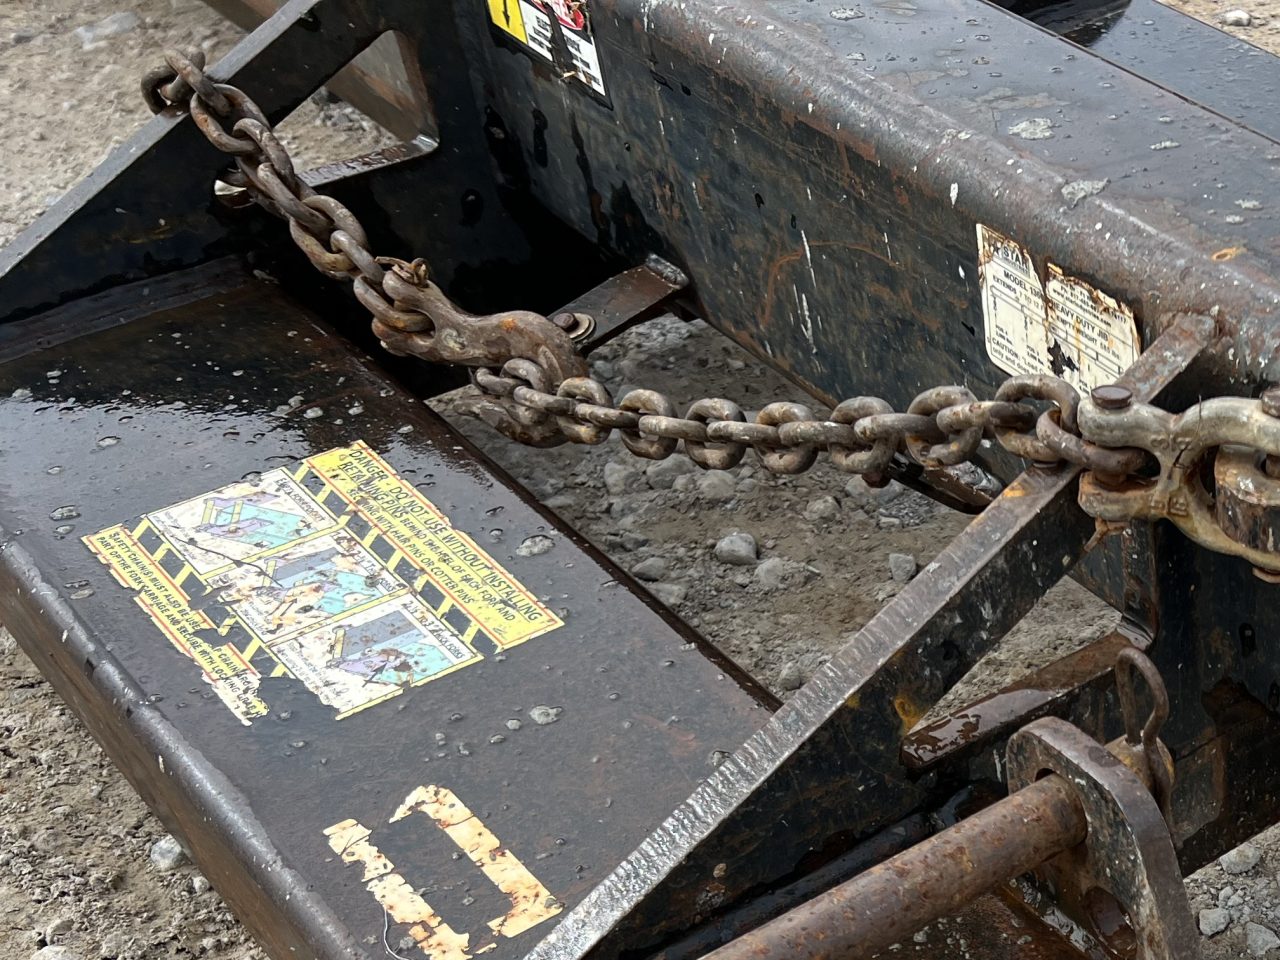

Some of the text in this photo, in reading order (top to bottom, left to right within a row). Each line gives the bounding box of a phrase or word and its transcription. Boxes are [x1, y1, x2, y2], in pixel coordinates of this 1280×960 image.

[992, 273, 1016, 295] EXTENDS
[1003, 269, 1028, 292] MODEL
[1051, 299, 1074, 320] HEAVY
[1075, 314, 1095, 334] DUTY
[1096, 327, 1108, 343] JIB
[1055, 313, 1074, 331] EMPTY
[1074, 326, 1097, 346] WEIGHT
[338, 459, 518, 623] RETAINING PINS BEHIND THE HEEL OF EACH FORK AND
[344, 487, 476, 605] SECRING WITH HAIR PINS OR COTTER PINS
[347, 449, 390, 483] DANGER
[387, 485, 411, 501] DO
[402, 498, 430, 518] NOT
[421, 516, 449, 535] USE
[439, 532, 491, 573] WITHOUT
[481, 570, 545, 622] INSTALLING
[106, 531, 134, 554] SAFETY
[125, 552, 155, 579] CHAIN(S)
[147, 575, 169, 595] MUST
[161, 590, 183, 611] ALSO
[175, 606, 191, 620] BE
[94, 535, 115, 552] PART
[114, 557, 132, 572] THE
[124, 568, 145, 586] FORK
[138, 583, 171, 616] CARRIAGE
[174, 623, 202, 652] SECURE
[196, 647, 216, 668] WITH
[209, 662, 240, 696] LOCKING
[216, 650, 240, 676] CHAIN
